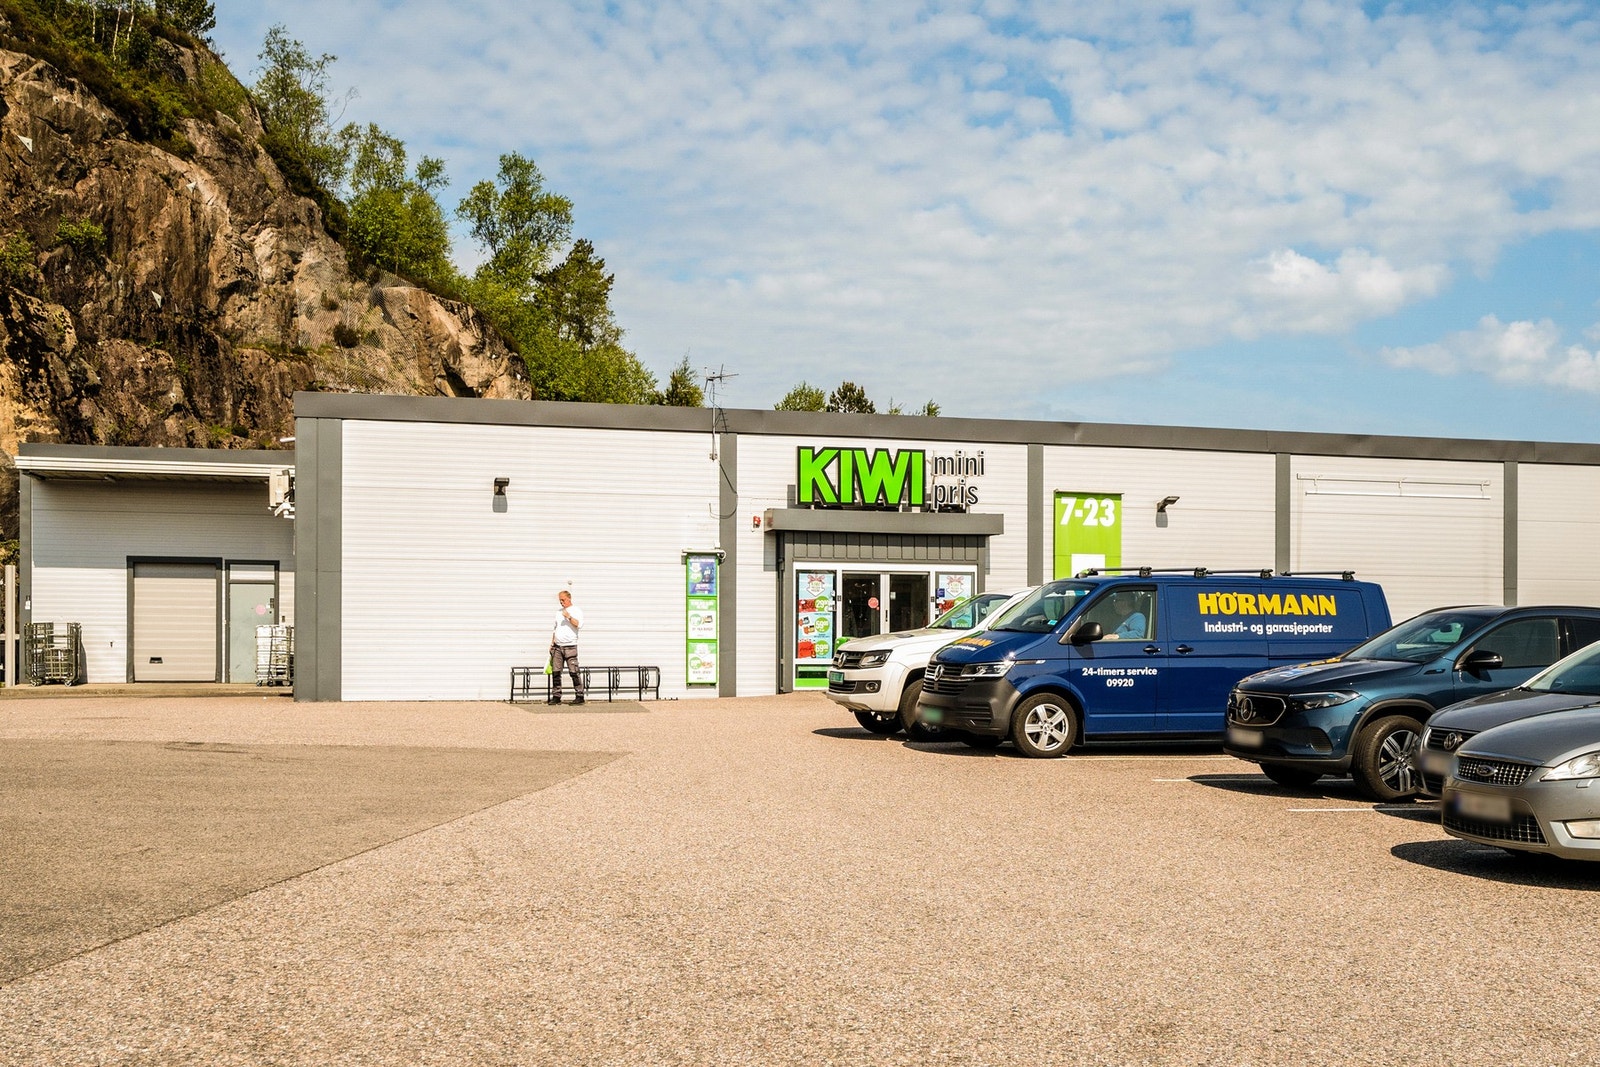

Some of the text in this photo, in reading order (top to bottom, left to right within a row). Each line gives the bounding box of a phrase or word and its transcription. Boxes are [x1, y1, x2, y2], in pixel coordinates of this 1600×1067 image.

[934, 450, 985, 476] mini
[797, 446, 926, 506] KIWI
[934, 479, 979, 510] pris
[1060, 497, 1115, 527] 7-23
[1198, 592, 1337, 616] HÖRMANN
[1204, 621, 1333, 635] Industri- og garasjeporter
[1082, 667, 1158, 676] 24-timers service
[1106, 678, 1134, 687] 09920
